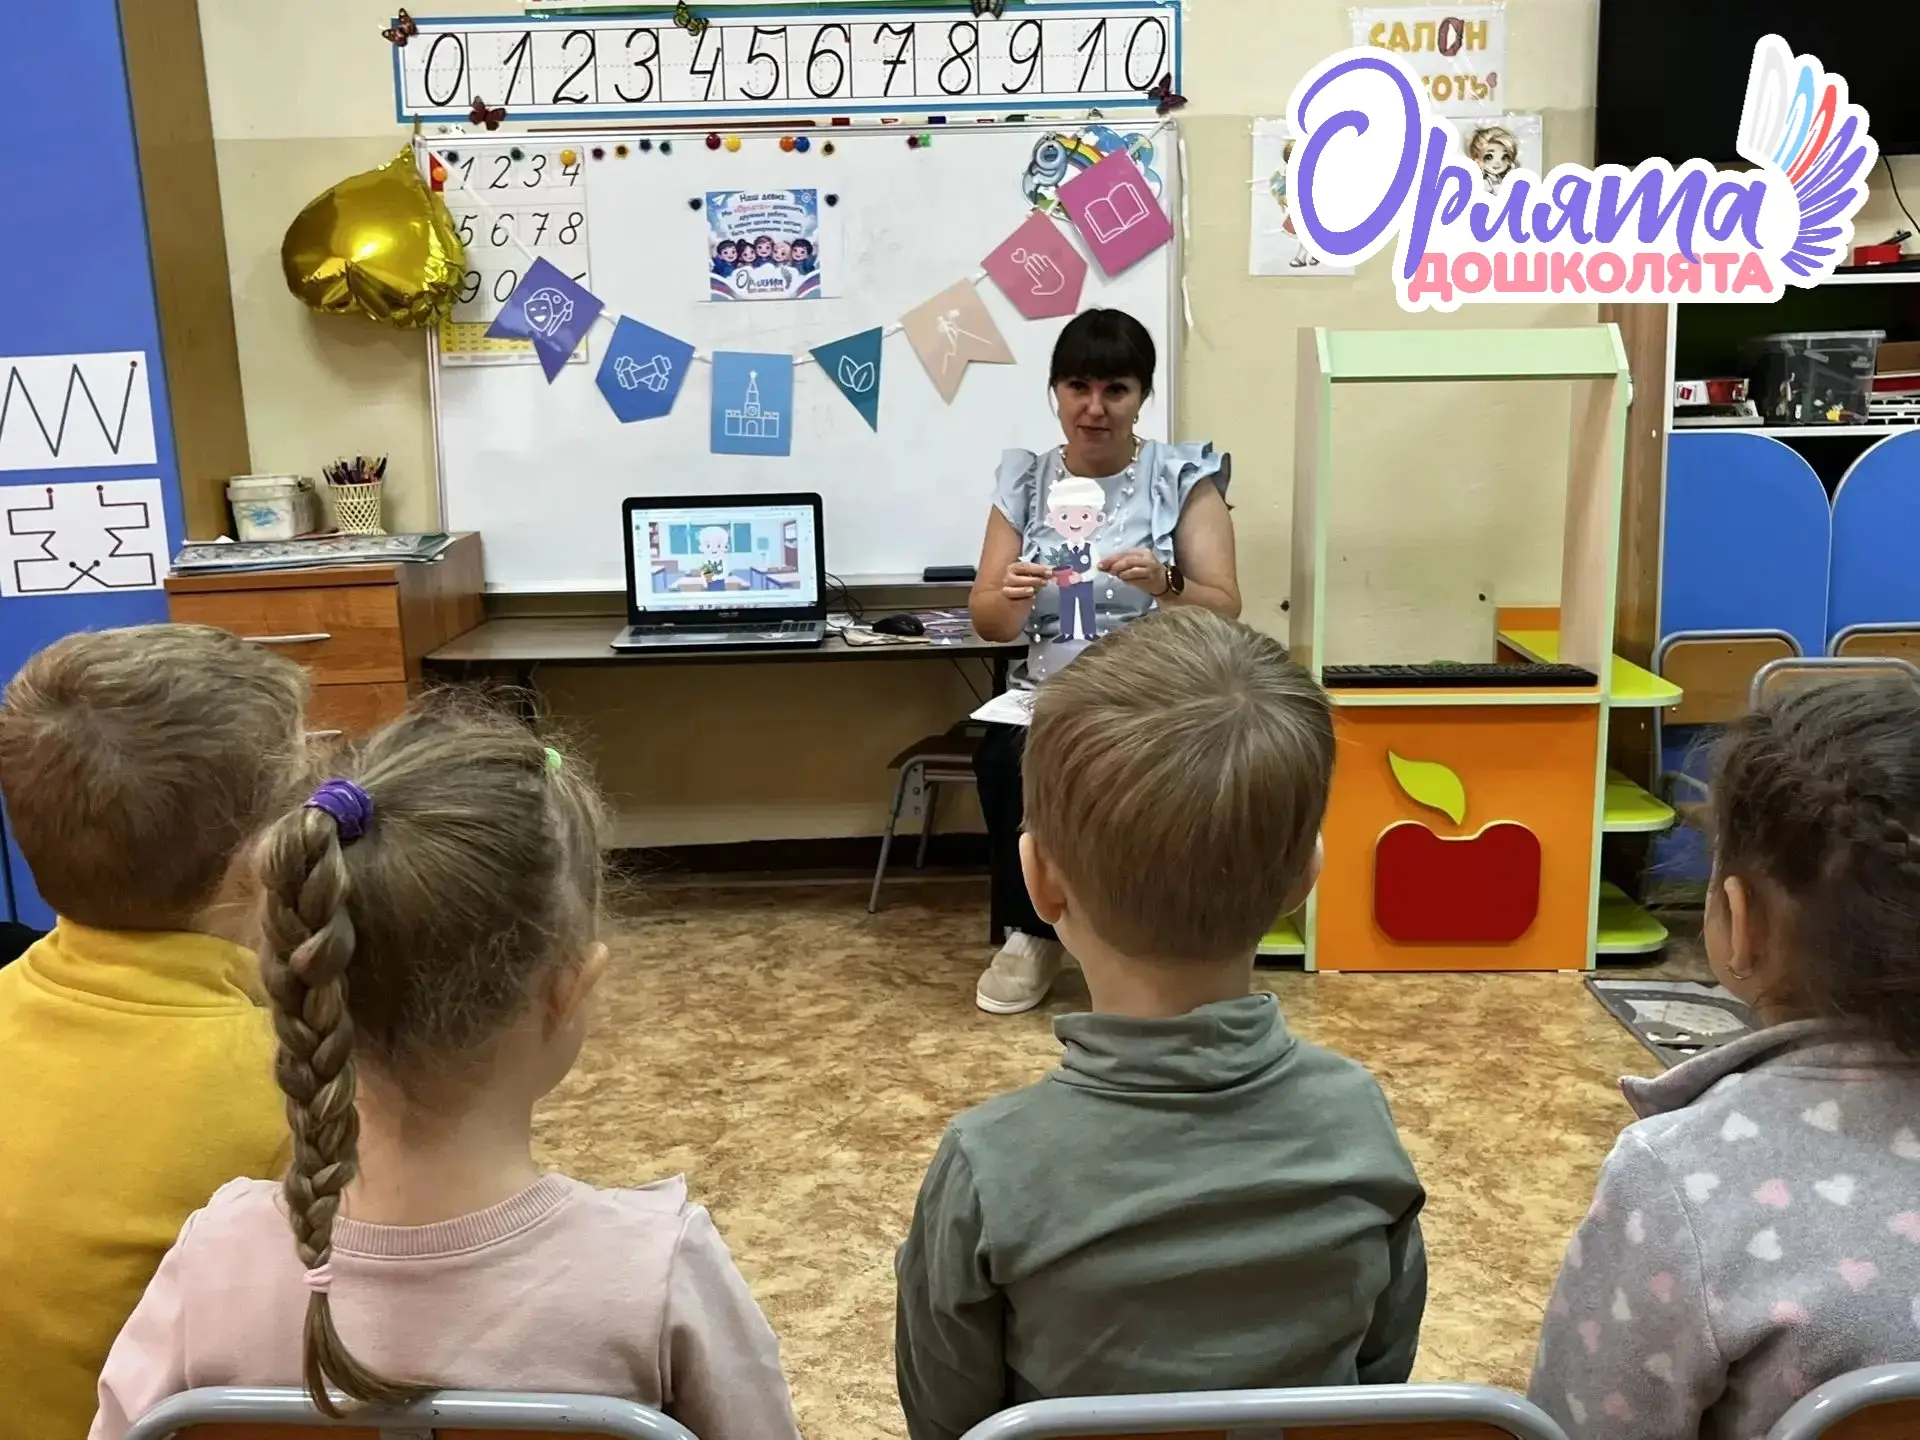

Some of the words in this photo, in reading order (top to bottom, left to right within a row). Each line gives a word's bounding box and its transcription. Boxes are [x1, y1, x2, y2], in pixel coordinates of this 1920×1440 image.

[1369, 17, 1487, 56] САЛОН
[424, 32, 464, 106] 0
[503, 31, 531, 105] 1
[552, 30, 595, 104] 2
[614, 28, 659, 103] 3
[689, 27, 721, 101] 4
[740, 26, 787, 101] 5
[806, 24, 850, 98] 6
[873, 22, 915, 97] 7
[938, 21, 979, 95] 8
[1001, 19, 1042, 94] 9
[460, 157, 475, 190] 1
[489, 155, 512, 189] 2
[523, 155, 547, 188] 3
[562, 163, 580, 187] 4
[460, 214, 478, 247] 5
[490, 213, 514, 247] 6
[532, 213, 550, 246] 7
[558, 212, 583, 245] 8
[458, 270, 482, 303] 9
[494, 269, 517, 303] 0
